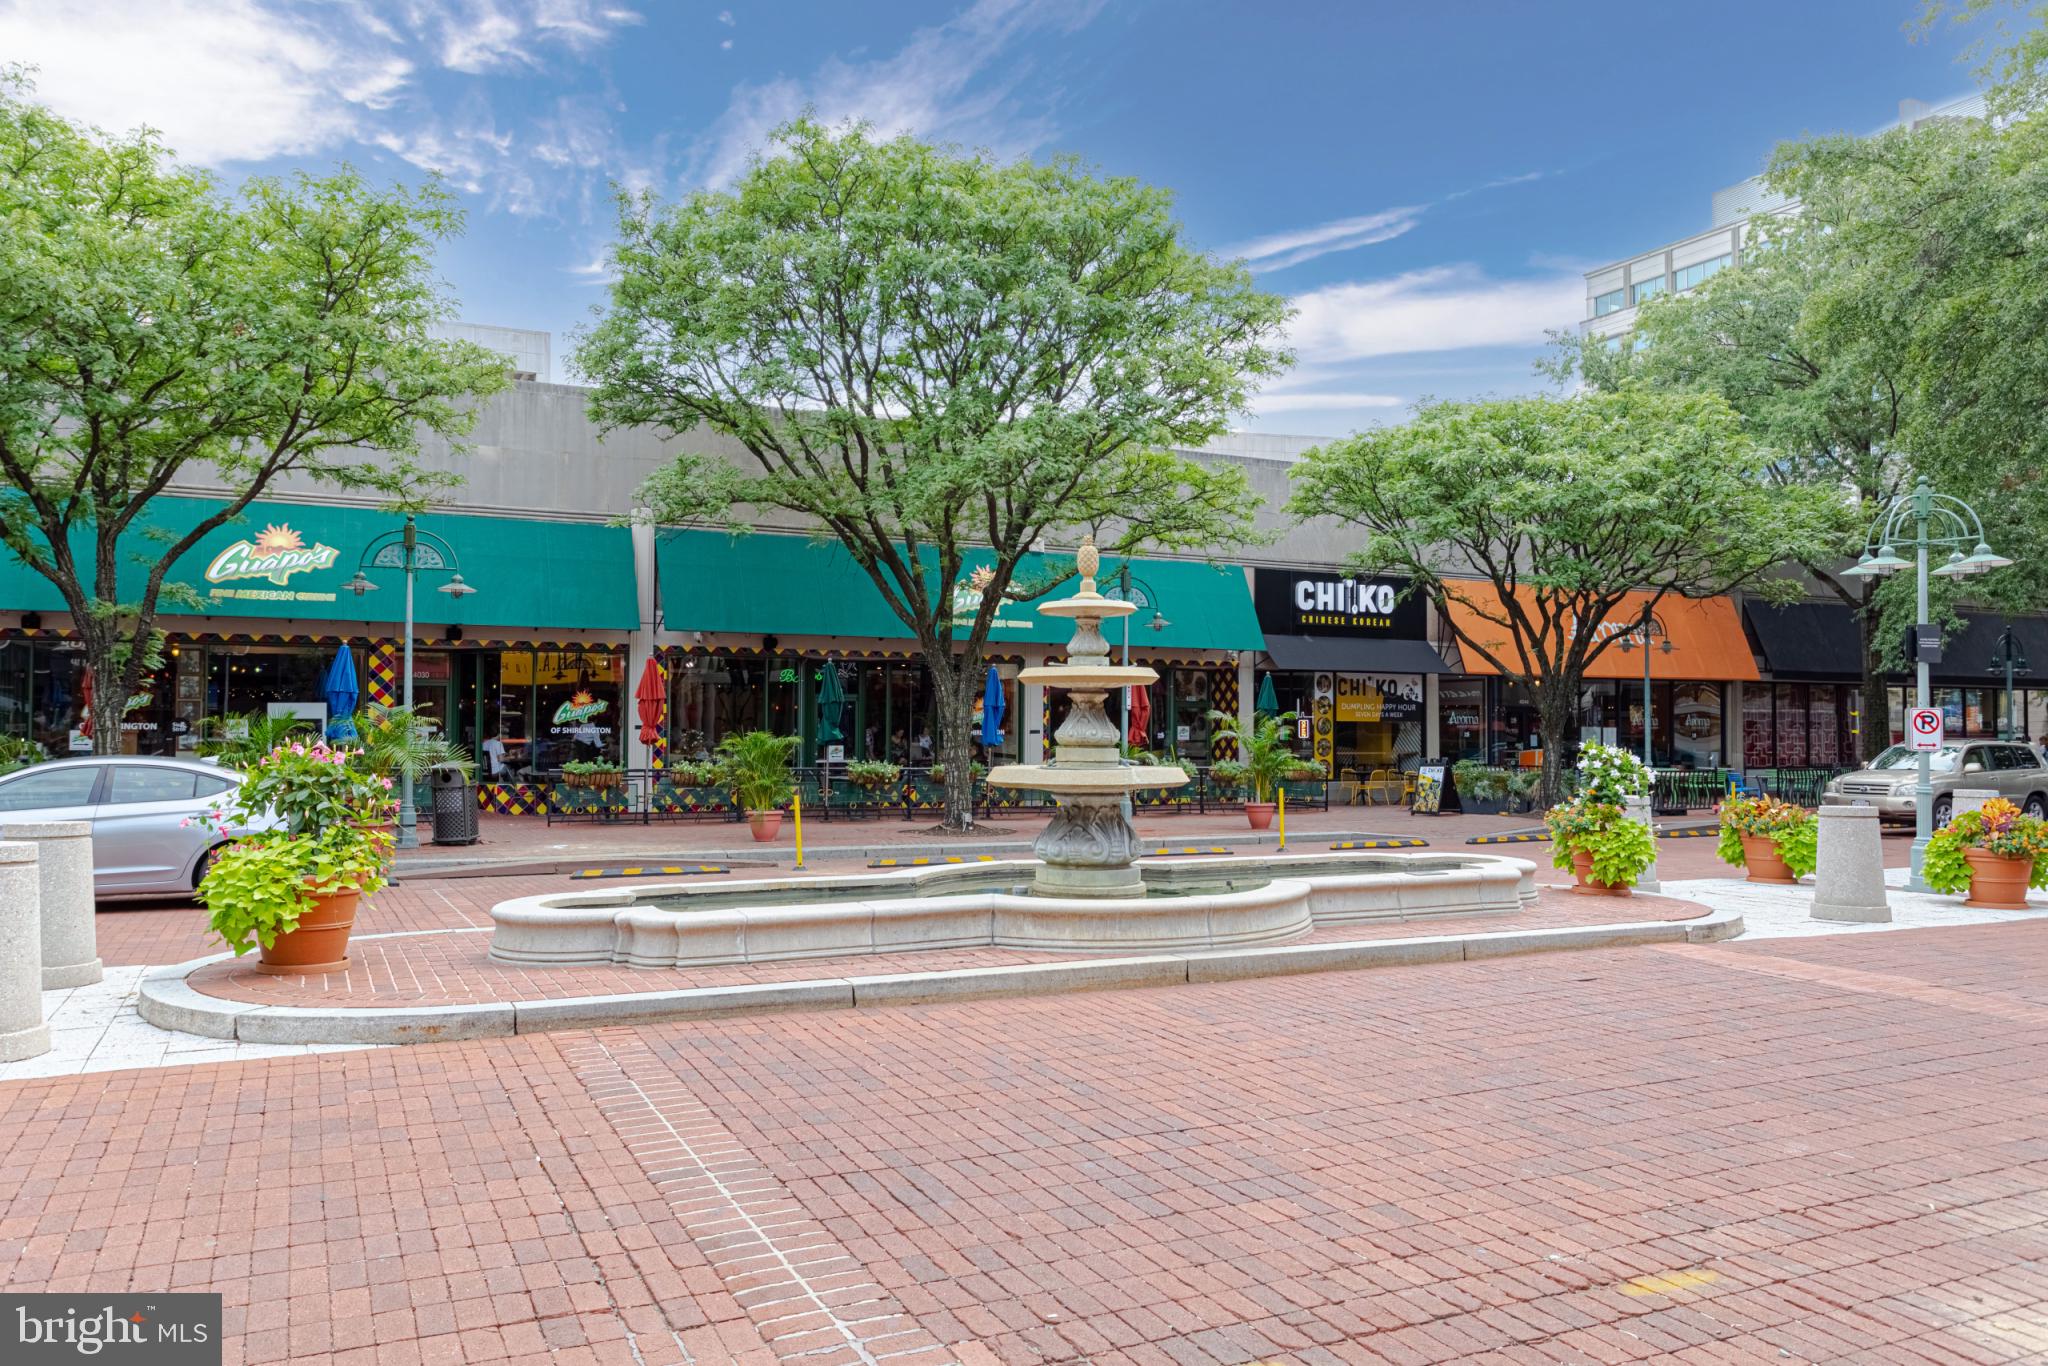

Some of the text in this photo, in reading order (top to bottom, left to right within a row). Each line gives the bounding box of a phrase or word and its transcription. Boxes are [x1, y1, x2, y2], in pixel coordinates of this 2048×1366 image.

[208, 543, 332, 581] Guapo's
[235, 590, 295, 600] MEXICAN
[1301, 615, 1391, 627] CHINESE KOREAN
[1376, 703, 1396, 711] HAPPY
[121, 723, 158, 731] INGTON
